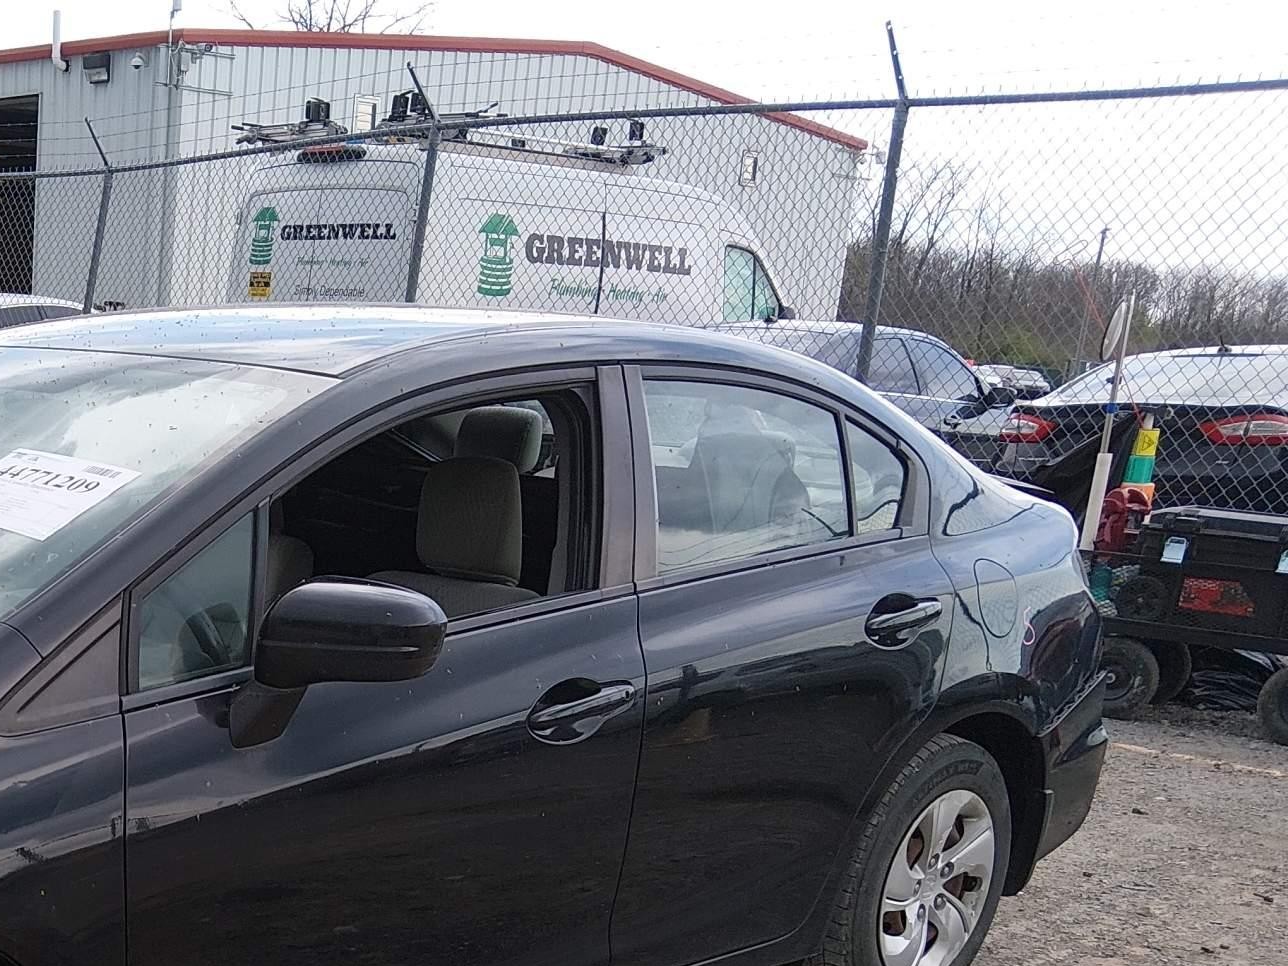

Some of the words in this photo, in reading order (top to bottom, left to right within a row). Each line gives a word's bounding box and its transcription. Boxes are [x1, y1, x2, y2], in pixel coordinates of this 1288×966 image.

[280, 222, 397, 242] GREENWELL
[524, 232, 692, 276] GREENWELL
[320, 286, 366, 299] Dependable
[550, 277, 599, 304] Plumbing
[608, 282, 645, 307] Heating
